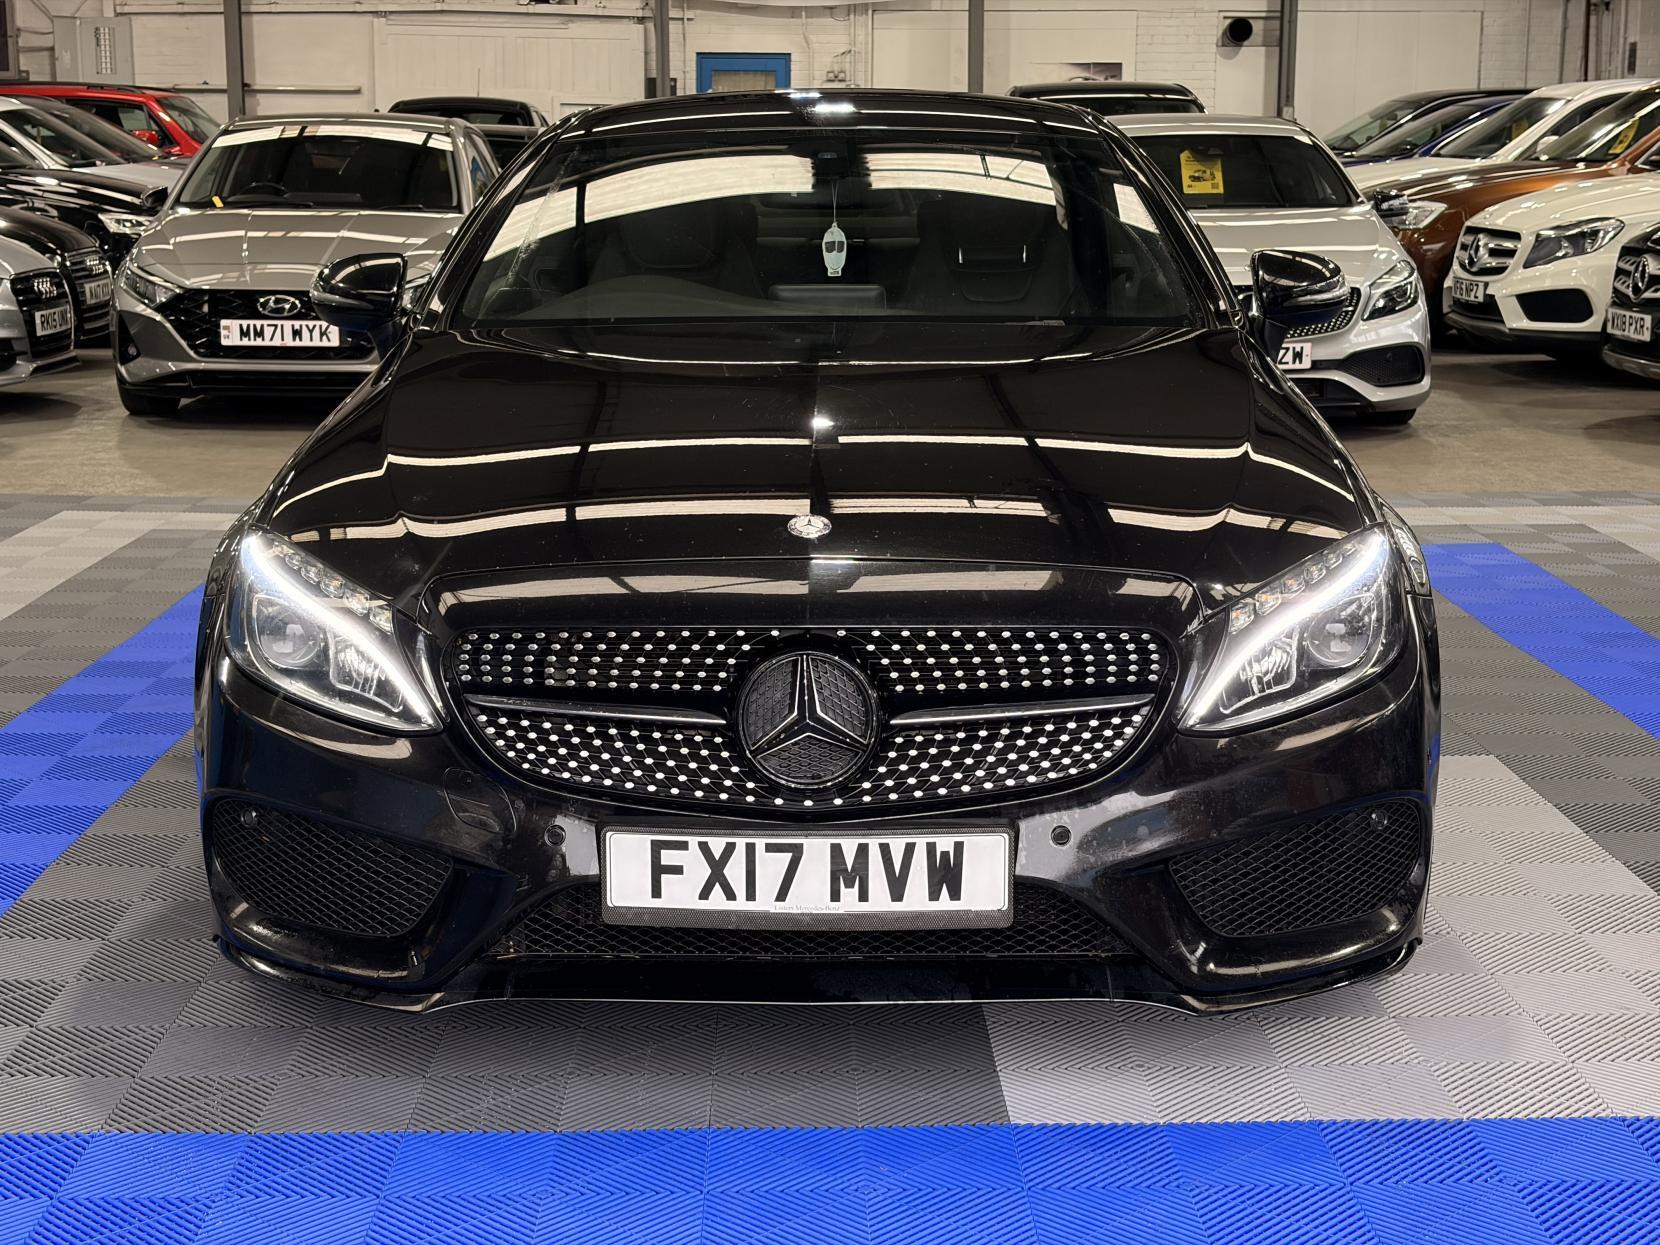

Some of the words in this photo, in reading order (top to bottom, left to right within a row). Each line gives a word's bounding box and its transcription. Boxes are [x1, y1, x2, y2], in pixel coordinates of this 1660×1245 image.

[1465, 281, 1480, 299] NPZ
[40, 311, 58, 332] RK15
[1611, 311, 1627, 332] WX18
[1628, 314, 1645, 337] PXR
[239, 323, 284, 342] MM71
[291, 323, 332, 342] WYK
[1277, 345, 1304, 365] ZW
[650, 839, 804, 902] FX17
[829, 840, 964, 902] MVW
